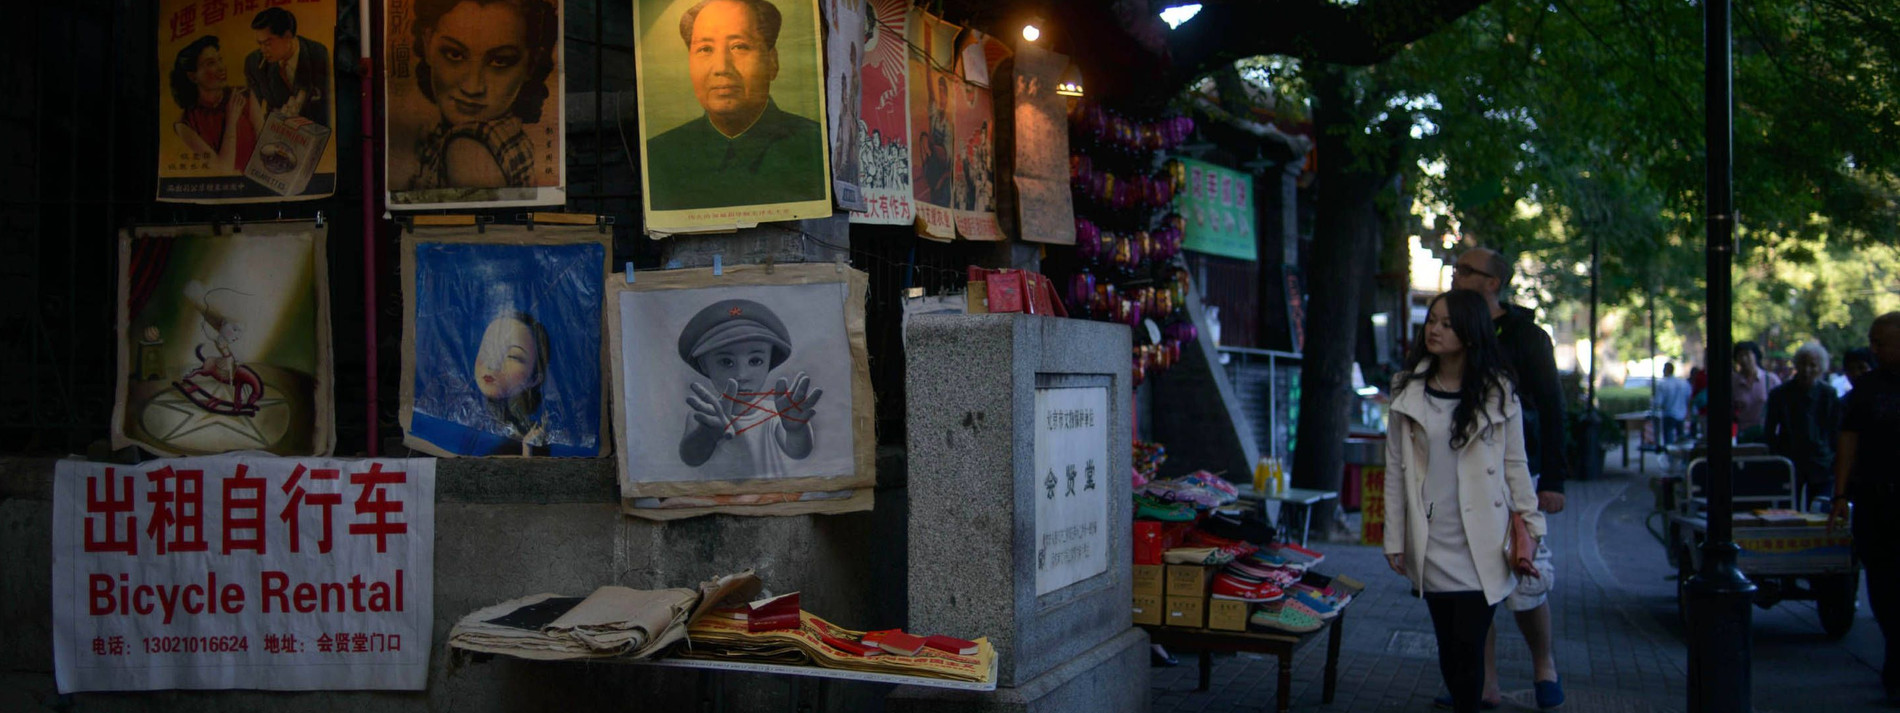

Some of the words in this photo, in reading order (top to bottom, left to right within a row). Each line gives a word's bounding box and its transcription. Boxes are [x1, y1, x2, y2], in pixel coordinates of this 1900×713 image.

[1044, 459, 1096, 500] 会贤堂
[83, 463, 408, 556] 出租自行车
[89, 571, 245, 624] Bicycle
[261, 570, 404, 614] Rental
[143, 635, 249, 654] 13021016624
